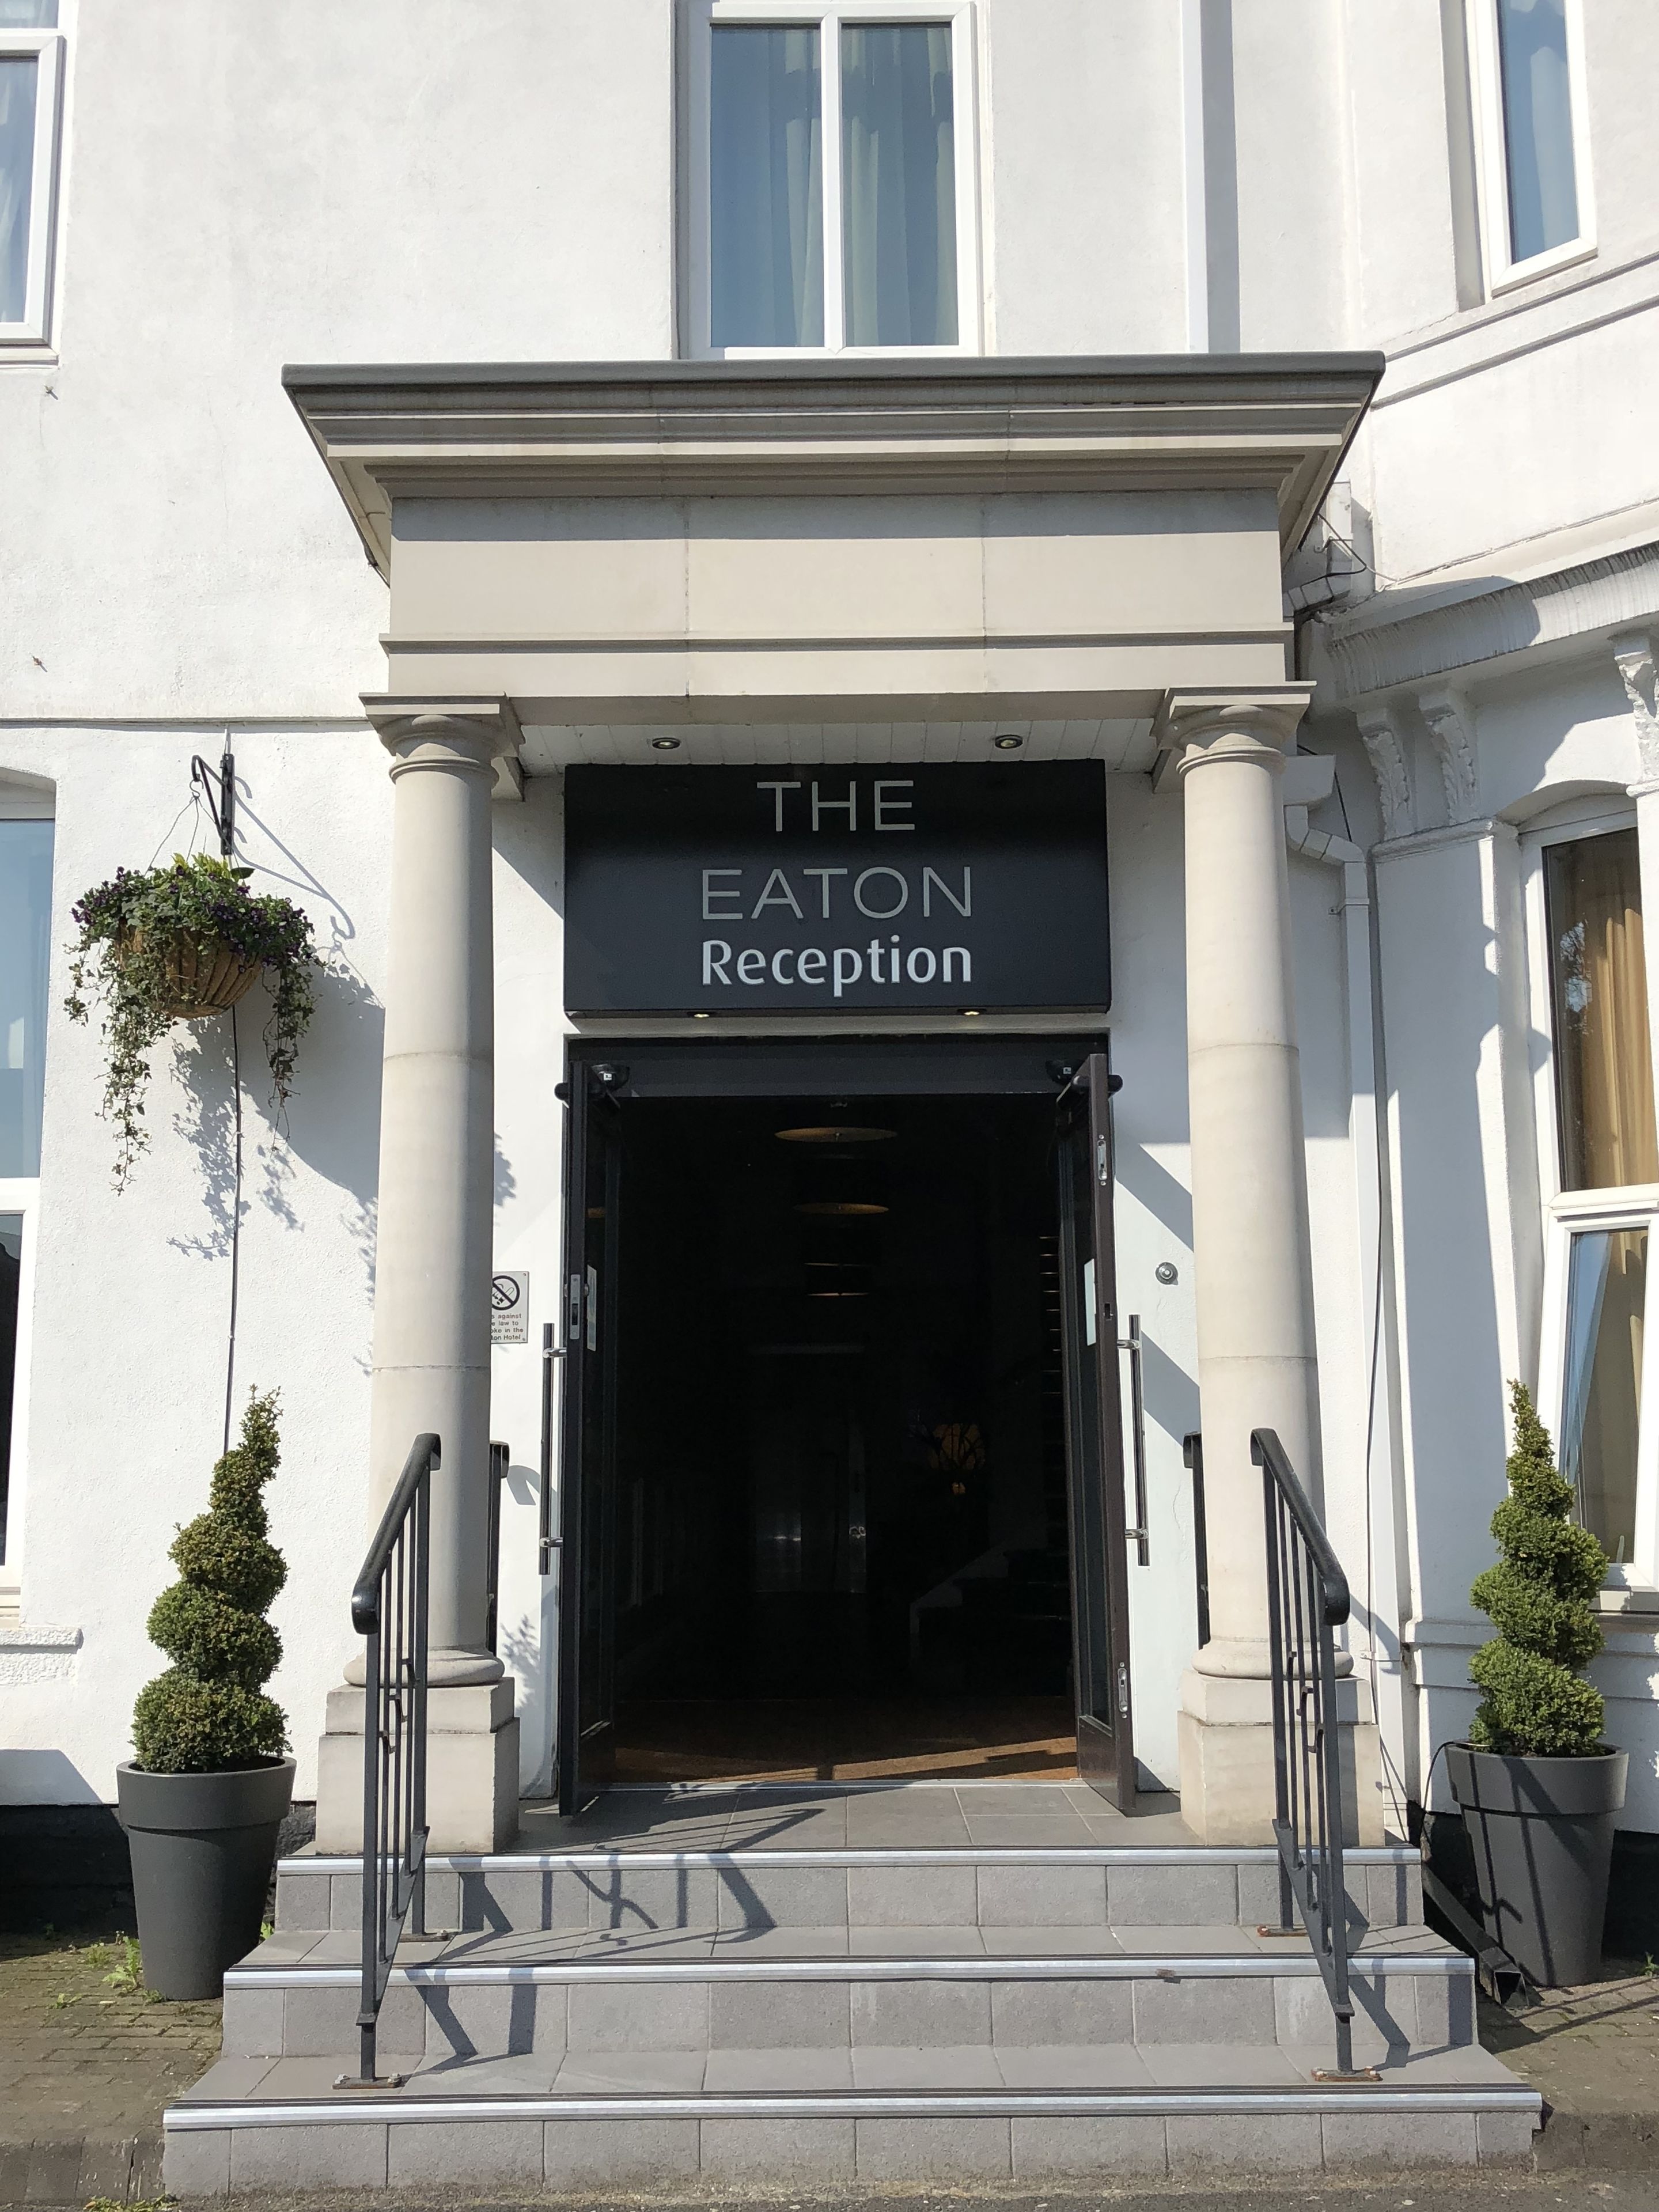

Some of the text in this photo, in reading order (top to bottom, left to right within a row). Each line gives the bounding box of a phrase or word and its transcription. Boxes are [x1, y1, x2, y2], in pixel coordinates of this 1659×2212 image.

[756, 779, 916, 832] THE
[702, 866, 972, 920] EATON
[702, 934, 972, 998] Reception
